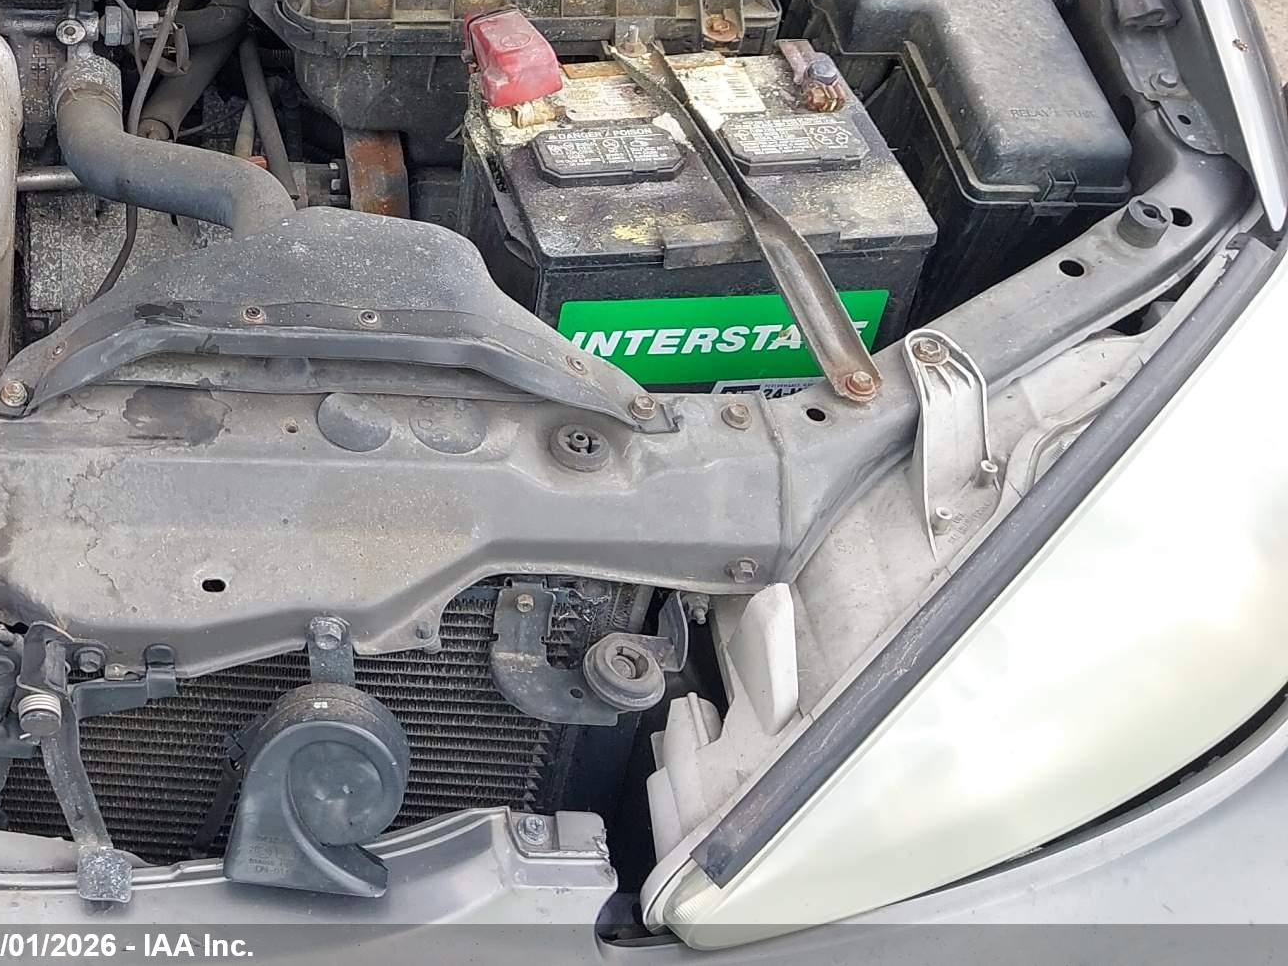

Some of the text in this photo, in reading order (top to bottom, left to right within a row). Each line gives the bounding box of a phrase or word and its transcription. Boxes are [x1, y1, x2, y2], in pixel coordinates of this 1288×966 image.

[558, 131, 603, 140] DANGER
[612, 127, 653, 137] POISON
[571, 320, 869, 357] INTERSTA
